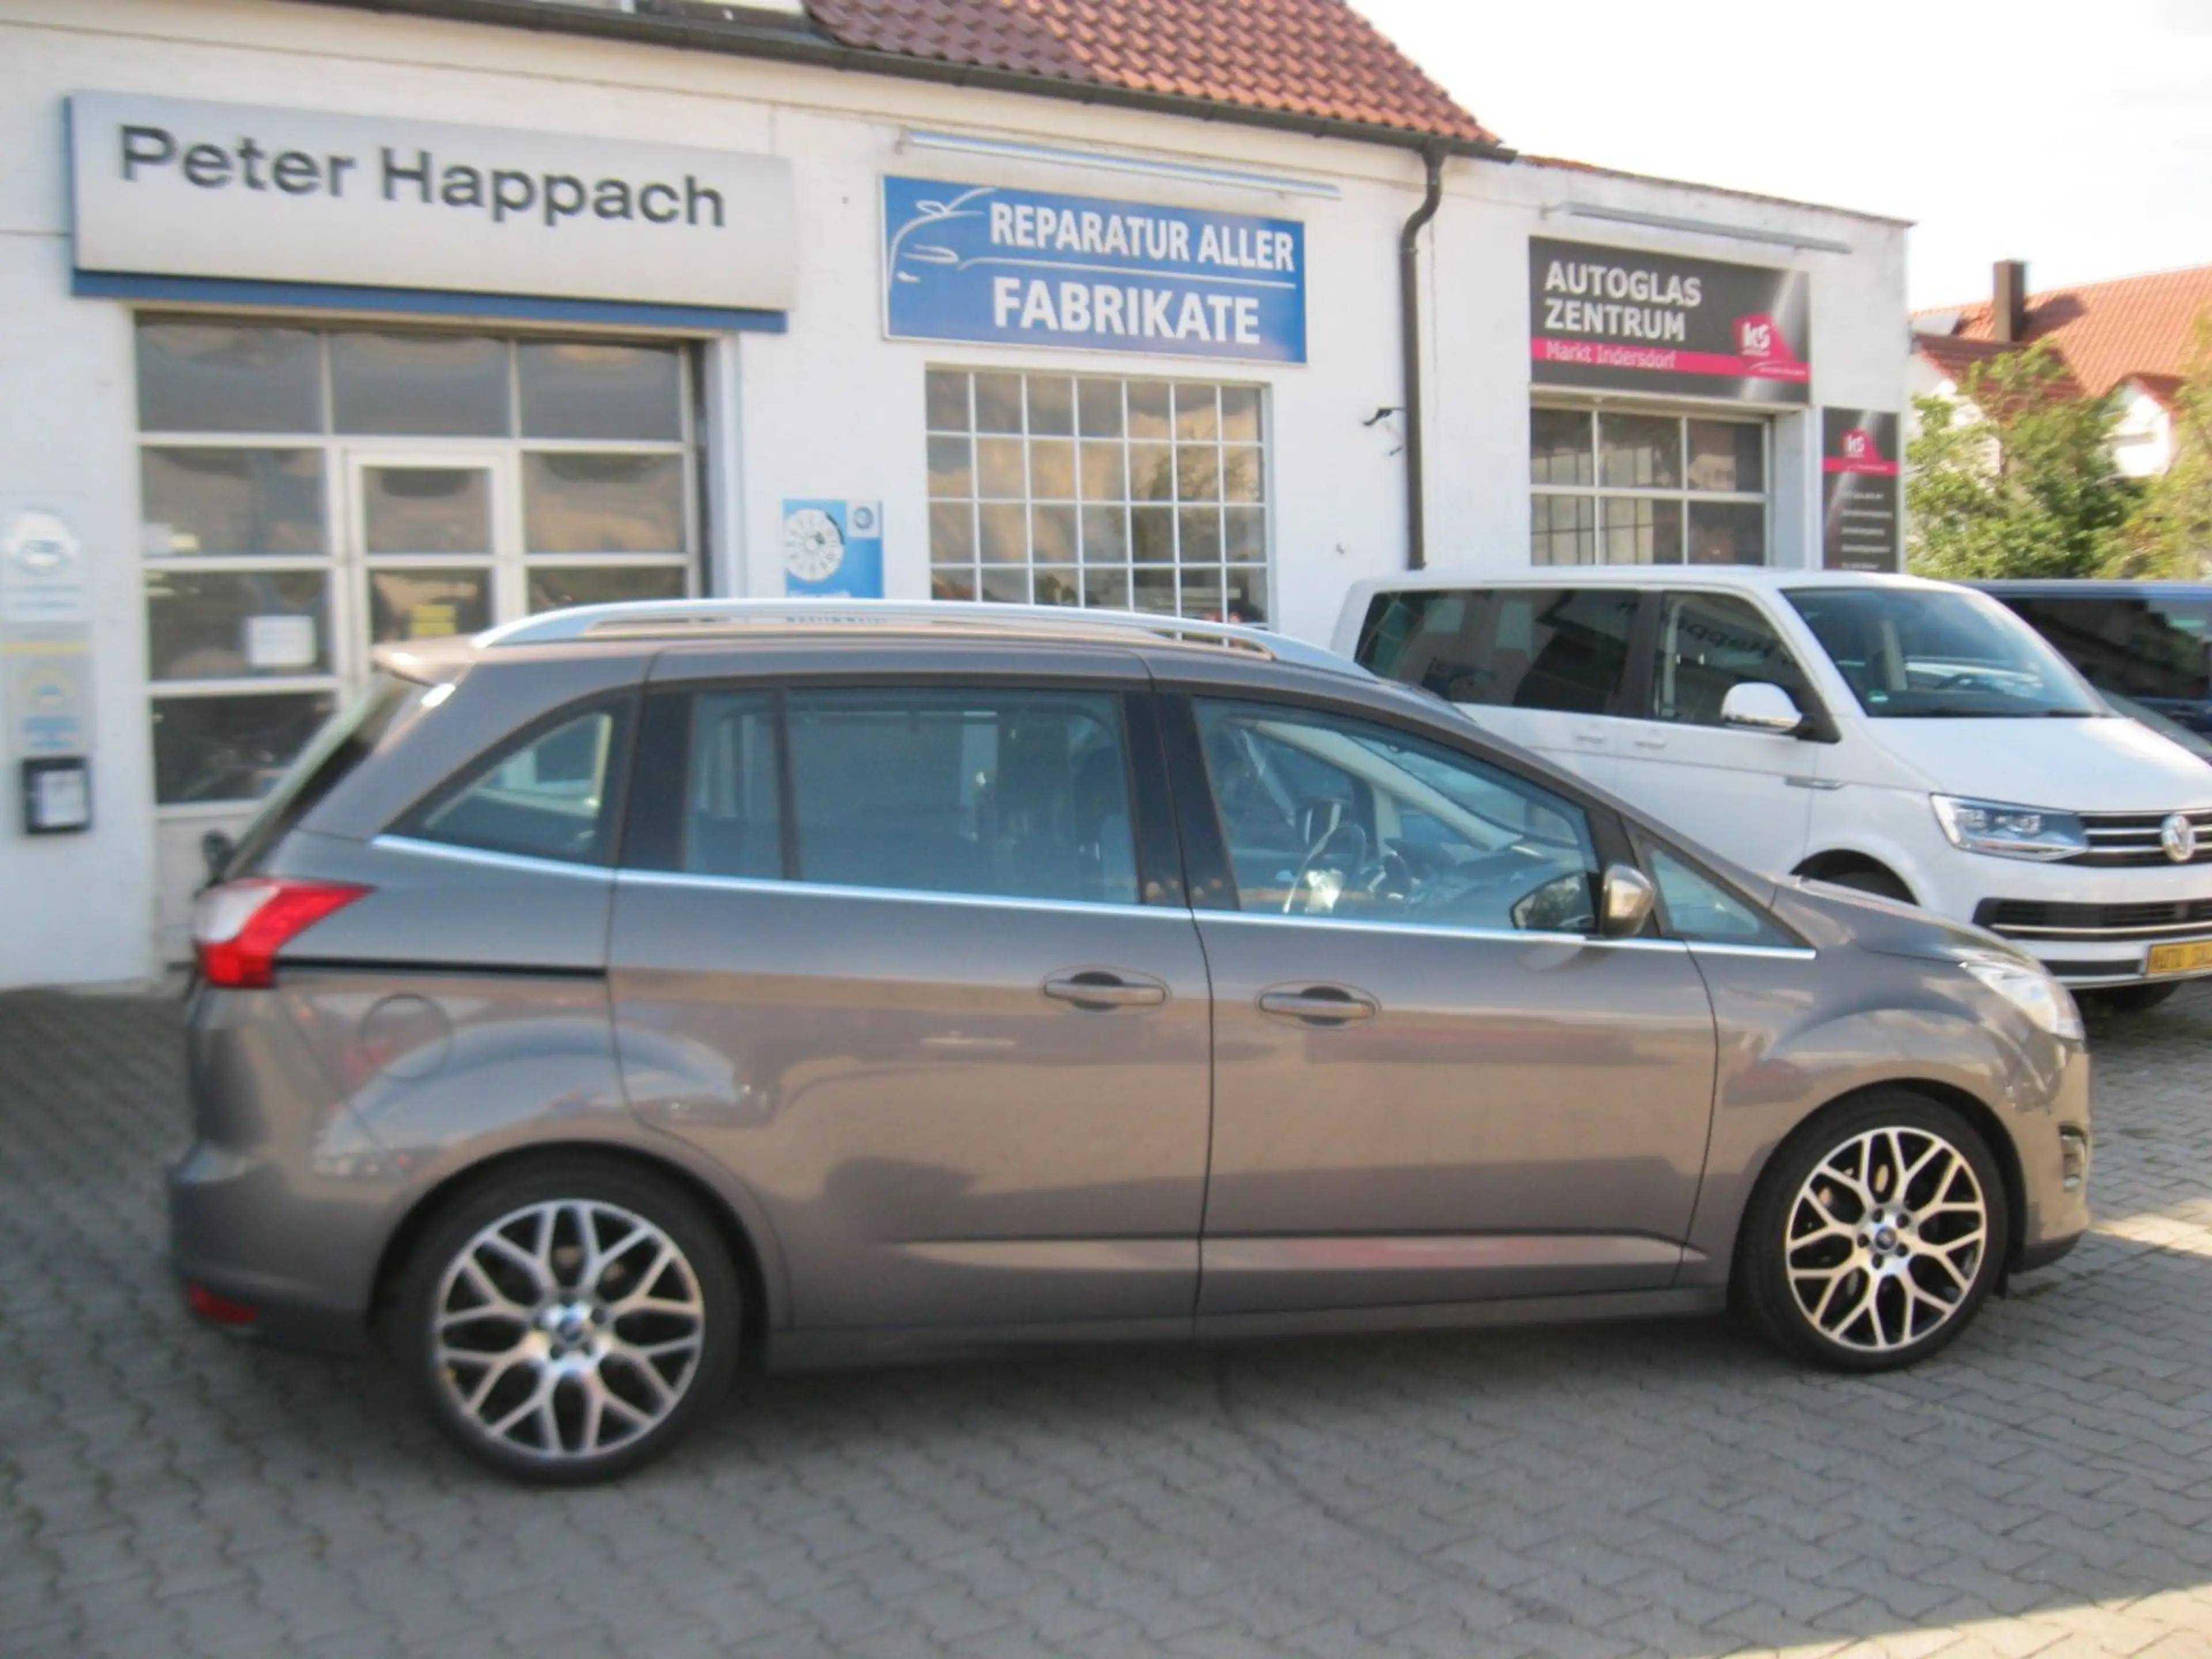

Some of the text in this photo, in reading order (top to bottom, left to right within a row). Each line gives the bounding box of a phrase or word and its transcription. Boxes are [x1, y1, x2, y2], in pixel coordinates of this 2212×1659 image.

[119, 124, 726, 228] Peter Happach
[990, 202, 1295, 272] REPARATUR ALLER
[993, 276, 1261, 344] FABRIKATE
[1544, 259, 1702, 308] AUTOGLAS
[1544, 297, 1685, 343] ZENTRUM
[1546, 340, 1593, 363] Markt
